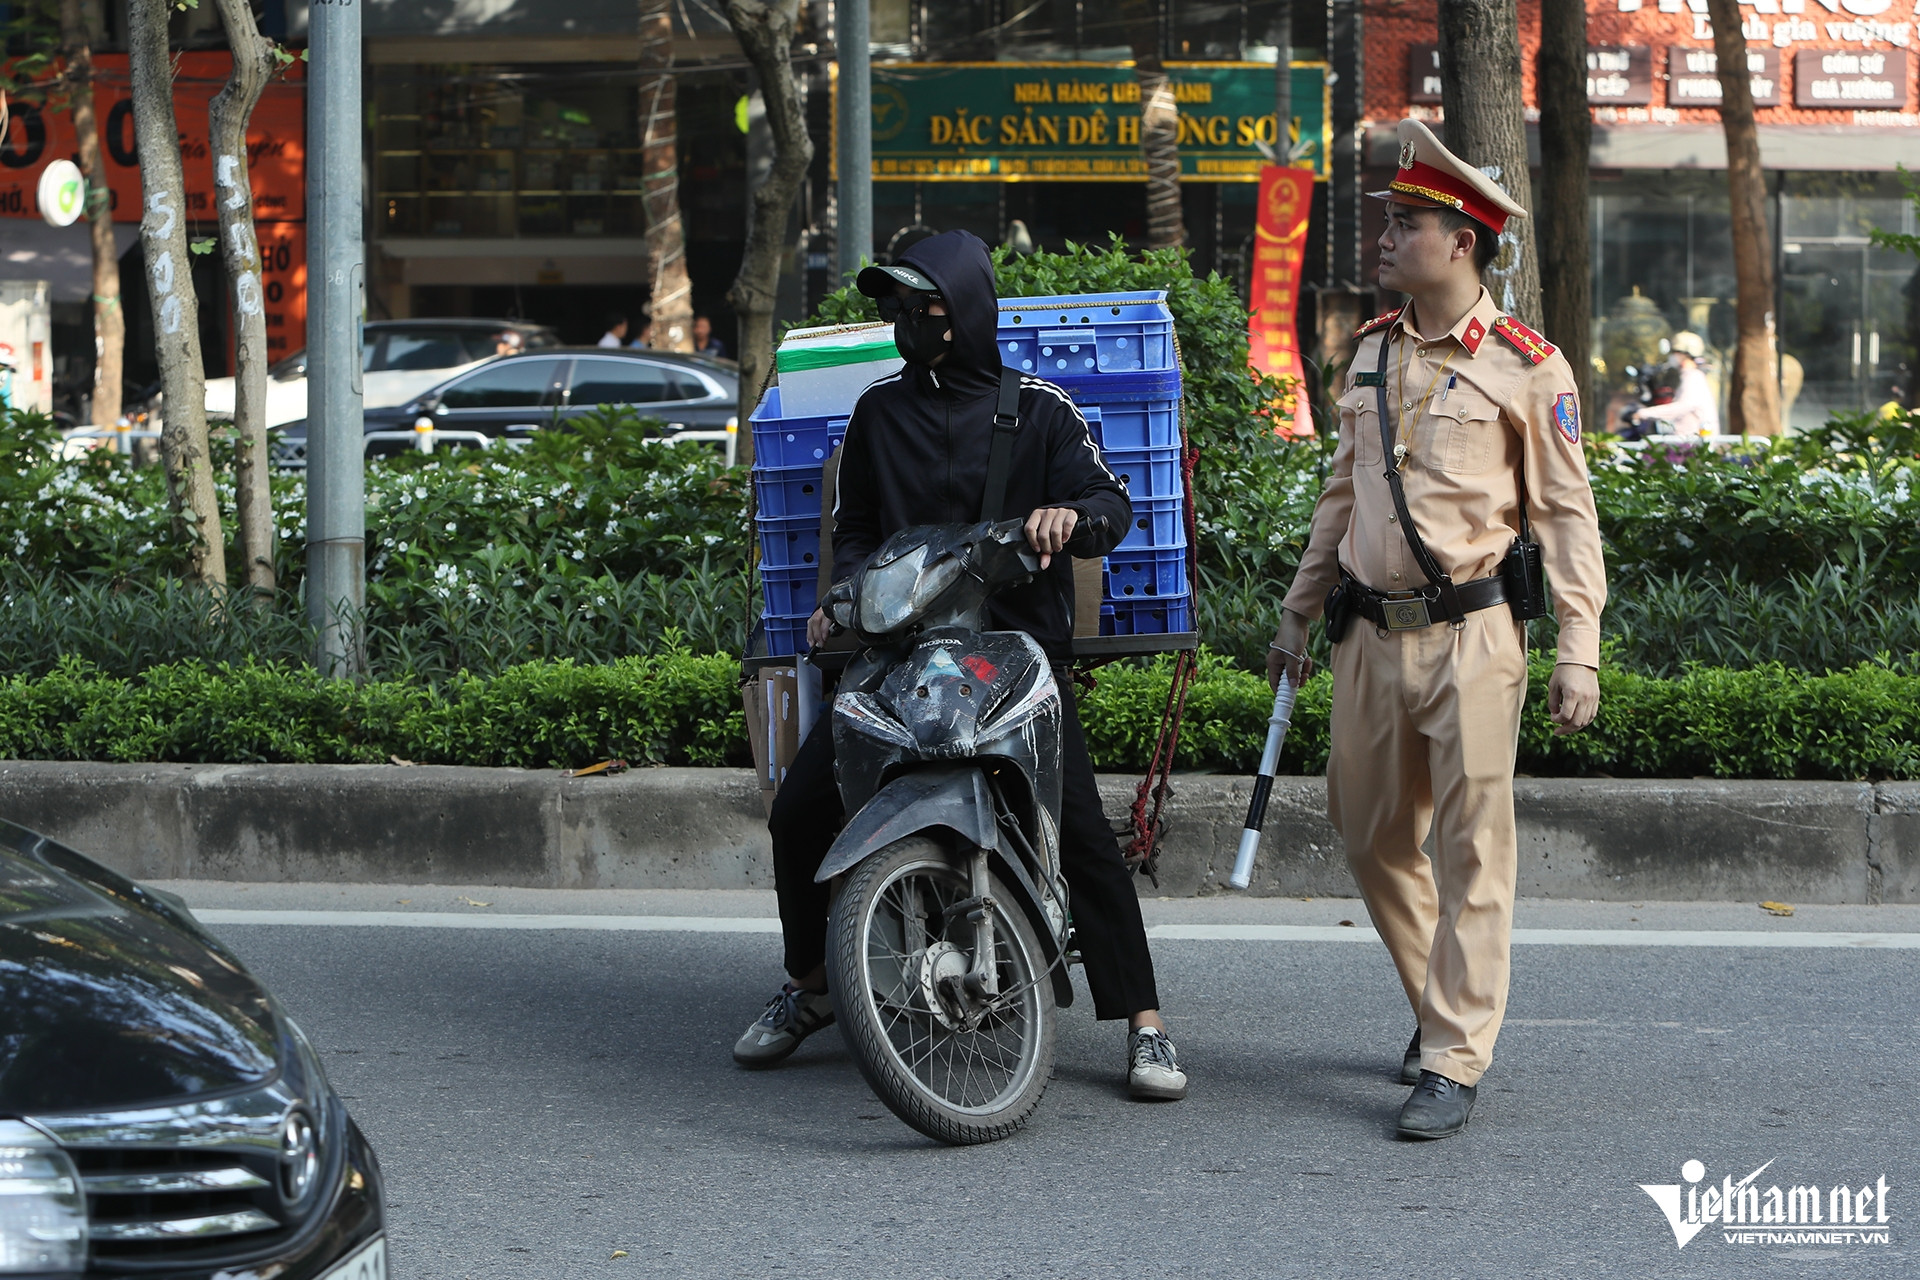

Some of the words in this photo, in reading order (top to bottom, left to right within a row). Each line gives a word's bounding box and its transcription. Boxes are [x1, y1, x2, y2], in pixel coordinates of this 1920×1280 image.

[1014, 79, 1053, 103] NHÀ
[1056, 79, 1109, 103] HÀNG
[931, 107, 992, 154] ĐẶC
[1000, 106, 1059, 145] SẢN
[1068, 108, 1110, 145] DÊ
[1117, 112, 1231, 146] HƠNG
[261, 235, 291, 272] HỞ
[893, 269, 919, 285] NIKE
[918, 638, 963, 649] HONDA
